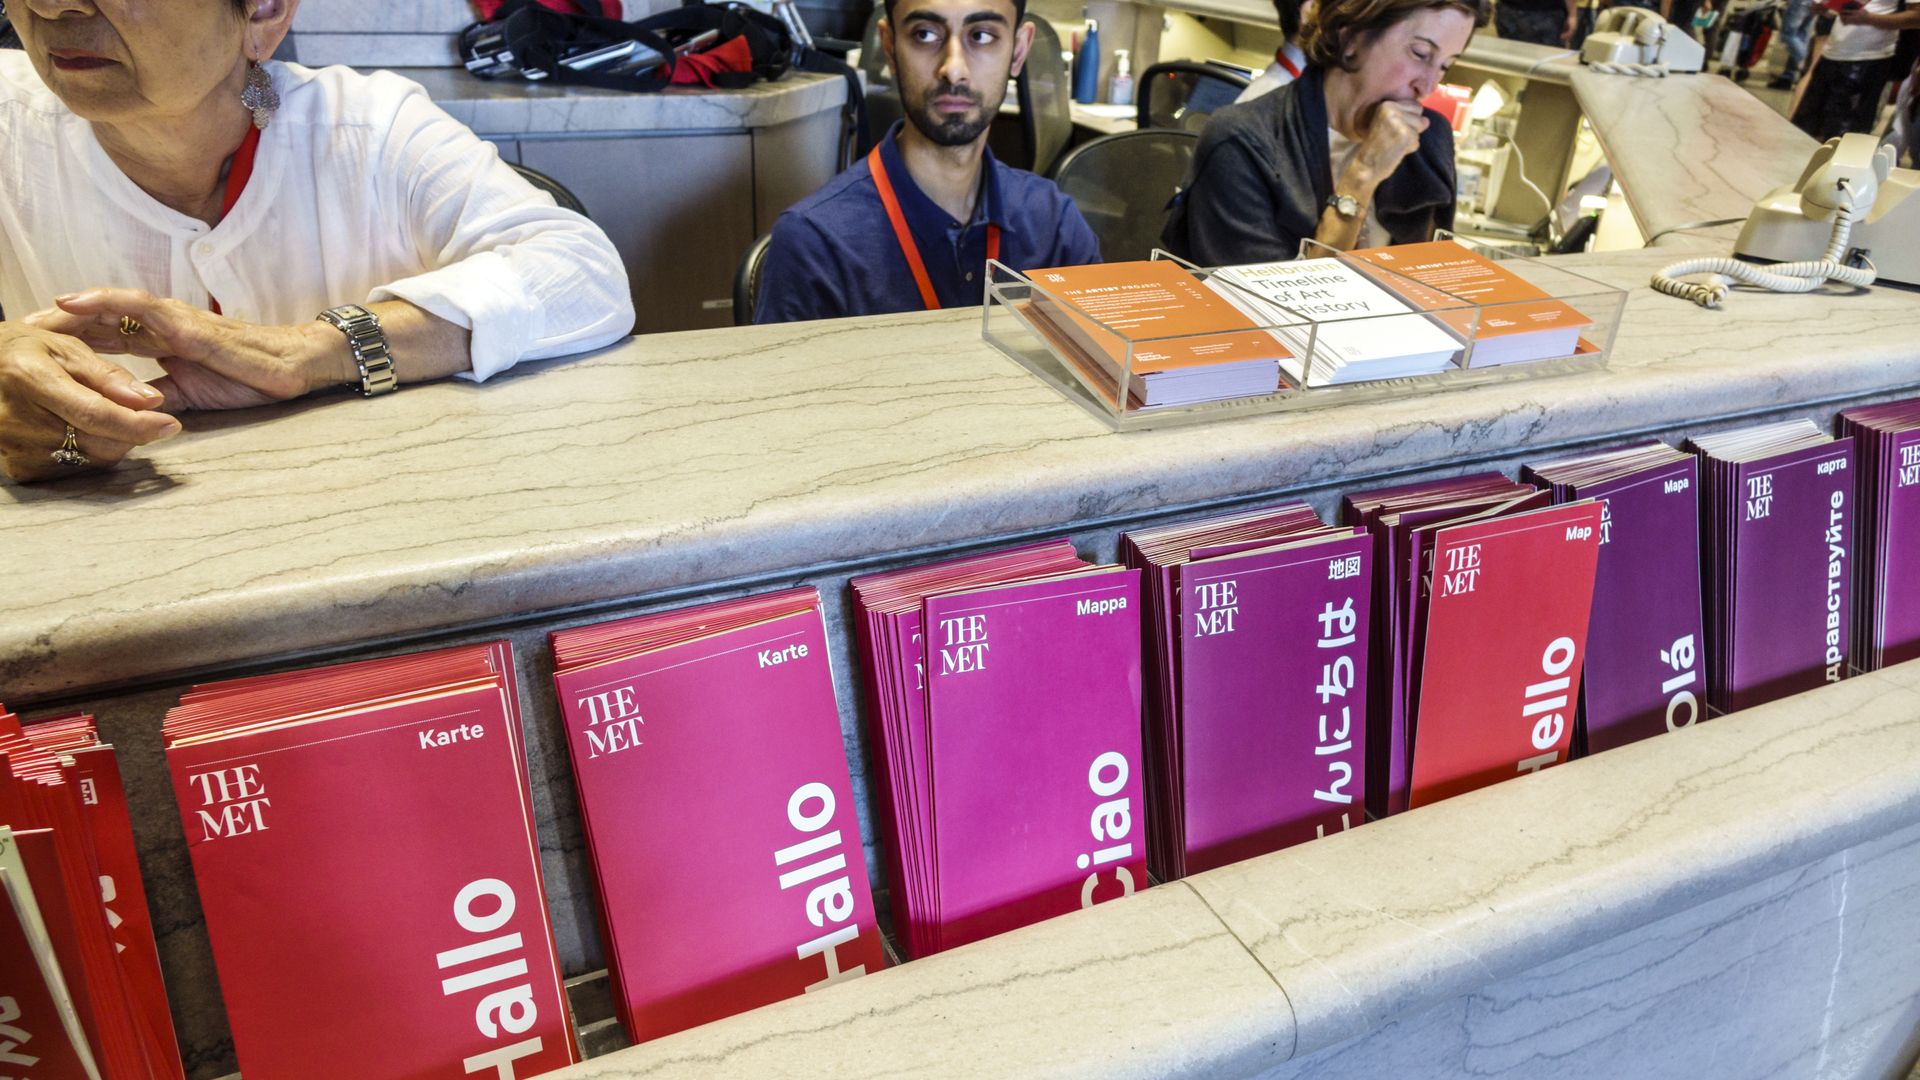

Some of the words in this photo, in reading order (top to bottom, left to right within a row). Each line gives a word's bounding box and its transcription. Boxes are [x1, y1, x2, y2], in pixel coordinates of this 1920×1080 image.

[1236, 262, 1339, 278] Heilbrunn
[1252, 273, 1347, 290] Timeline
[1085, 286, 1119, 294] ARTIST
[1274, 291, 1295, 302] of
[1300, 288, 1335, 300] Art
[1288, 300, 1371, 315] History
[1817, 458, 1847, 475] карта
[1664, 478, 1689, 494] Mapa
[1746, 474, 1773, 499] THE
[1745, 495, 1773, 521] MET
[1565, 526, 1592, 541] Map
[1328, 556, 1360, 580] 地図
[1445, 544, 1482, 572] THE
[1194, 580, 1238, 610] THE
[1441, 569, 1481, 598] MET
[1077, 597, 1127, 616] Mappa
[940, 614, 988, 646] THE
[1194, 607, 1239, 638] MET
[758, 643, 809, 668] Karte
[940, 643, 990, 676] MET
[1660, 633, 1698, 733] Olá
[578, 685, 640, 726] THE
[418, 724, 485, 750] Karte
[584, 716, 645, 760] MET
[190, 763, 265, 806] THE
[196, 797, 271, 842] MET
[774, 782, 867, 994] Hallo
